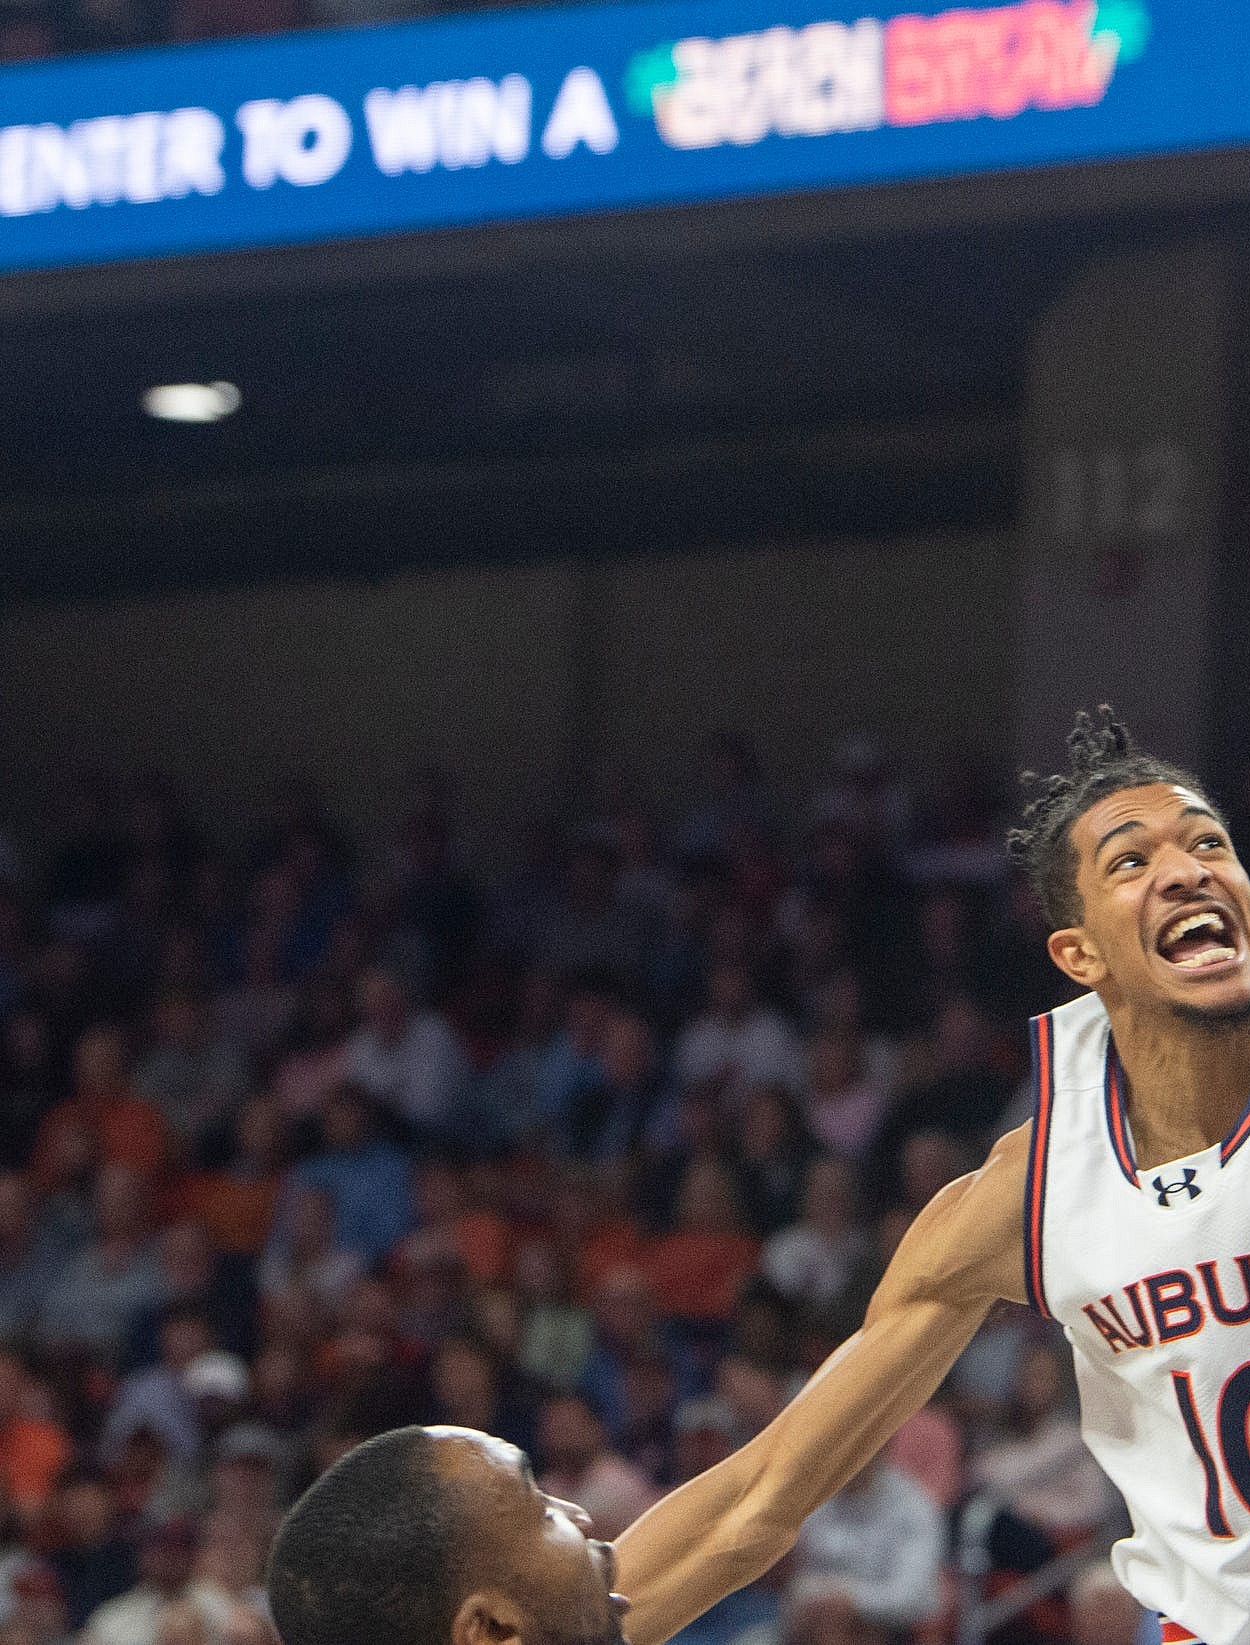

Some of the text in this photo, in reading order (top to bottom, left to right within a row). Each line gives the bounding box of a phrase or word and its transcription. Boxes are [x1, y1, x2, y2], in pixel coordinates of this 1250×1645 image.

[236, 94, 352, 190] TO
[364, 73, 532, 177] WIN
[541, 66, 619, 160] A
[1049, 441, 1193, 537] 112
